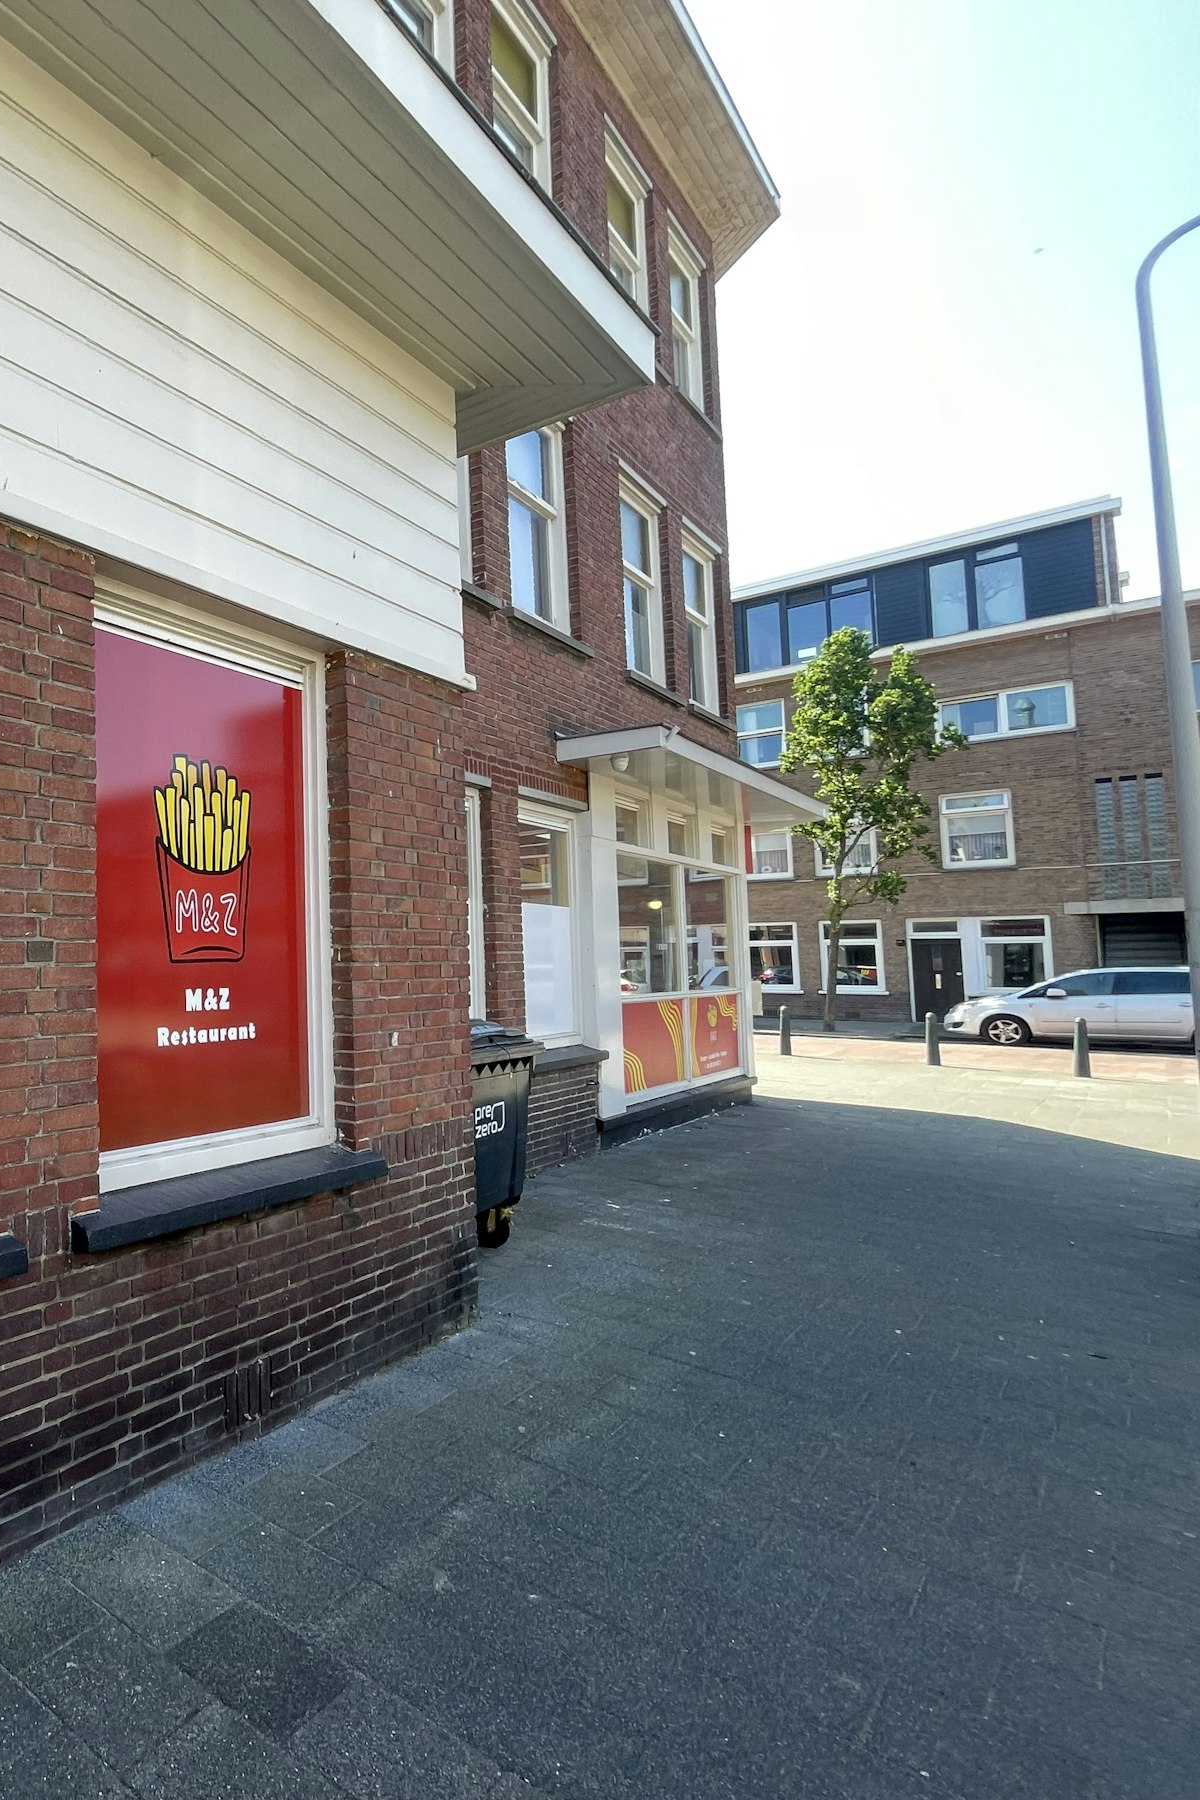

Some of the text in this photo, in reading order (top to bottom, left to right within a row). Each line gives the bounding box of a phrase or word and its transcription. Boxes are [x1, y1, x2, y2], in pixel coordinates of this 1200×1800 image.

[175, 889, 238, 936] M&Z
[185, 988, 230, 1012] M&Z
[157, 1022, 256, 1047] Restaurant
[474, 1104, 492, 1125] pre
[474, 1120, 499, 1139] zero
